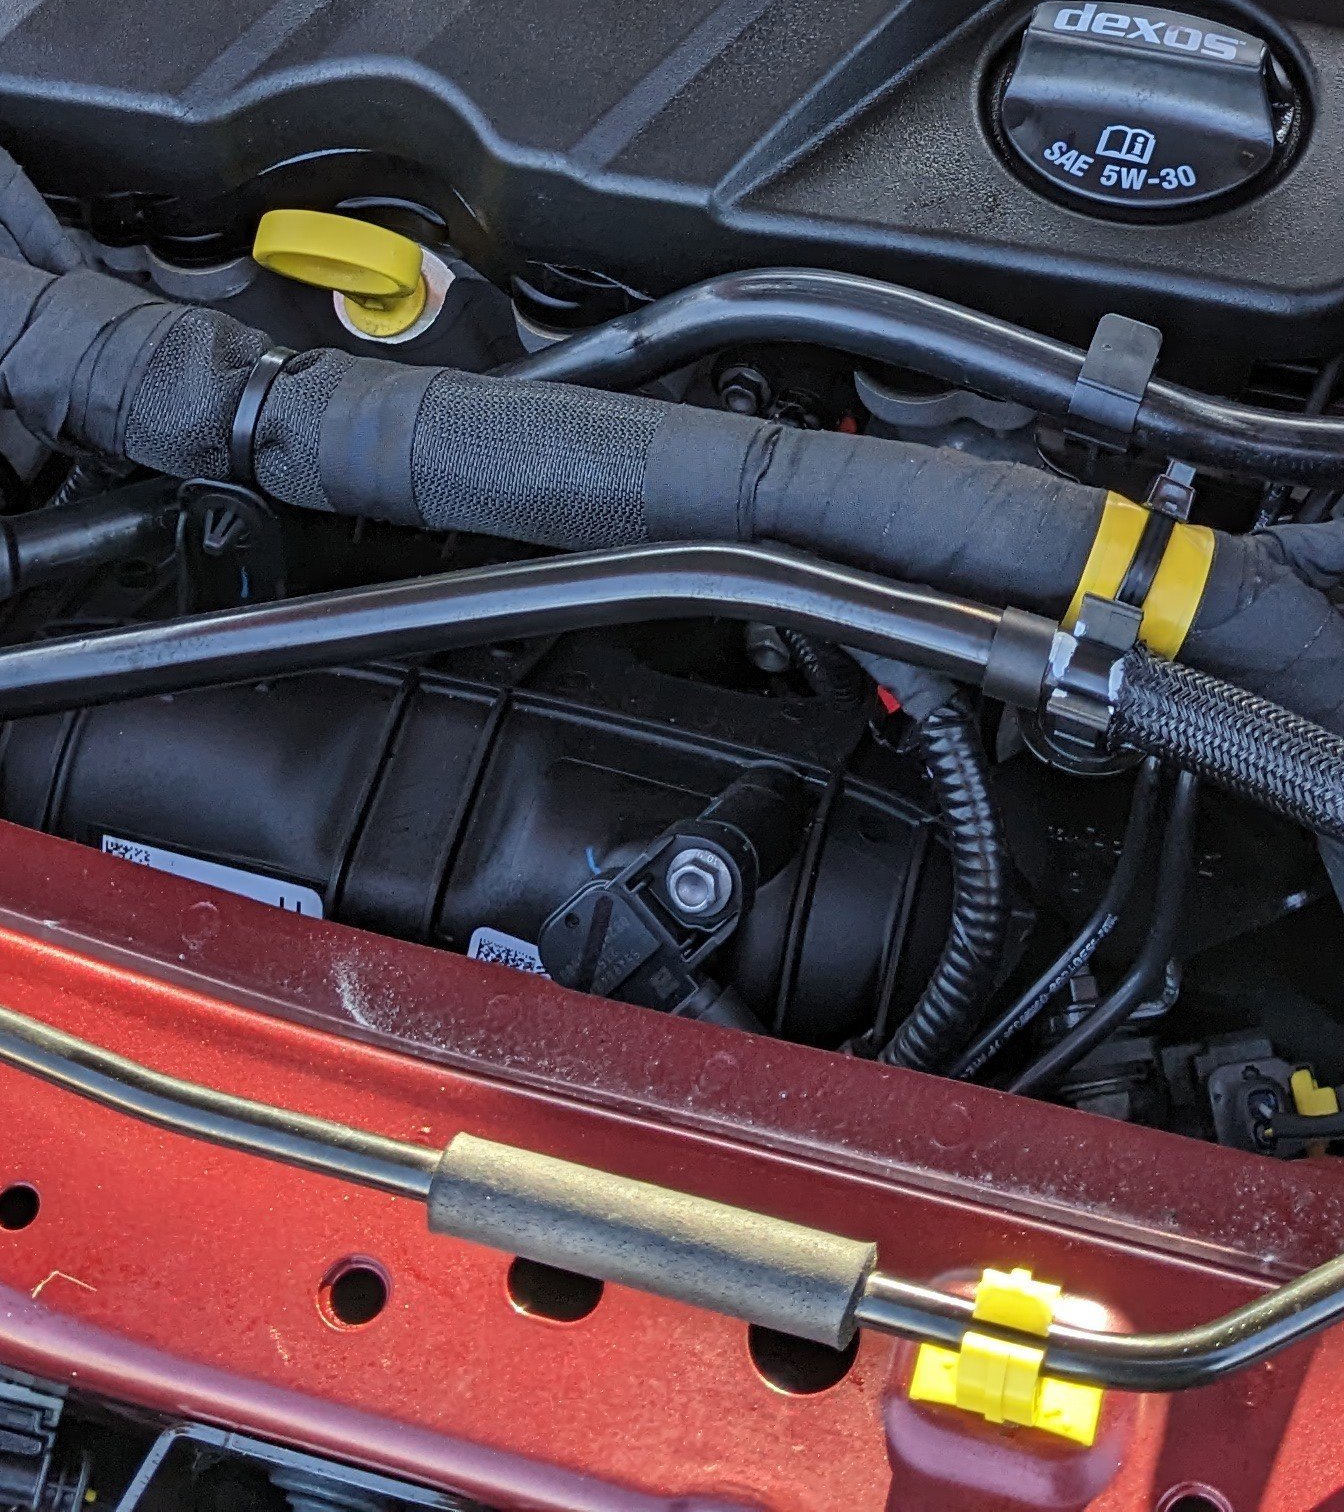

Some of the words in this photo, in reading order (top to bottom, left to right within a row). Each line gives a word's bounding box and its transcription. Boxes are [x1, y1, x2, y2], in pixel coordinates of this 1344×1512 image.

[1053, 3, 1238, 61] dexos
[1043, 141, 1094, 177] SAE
[1099, 164, 1197, 191] 5W-30
